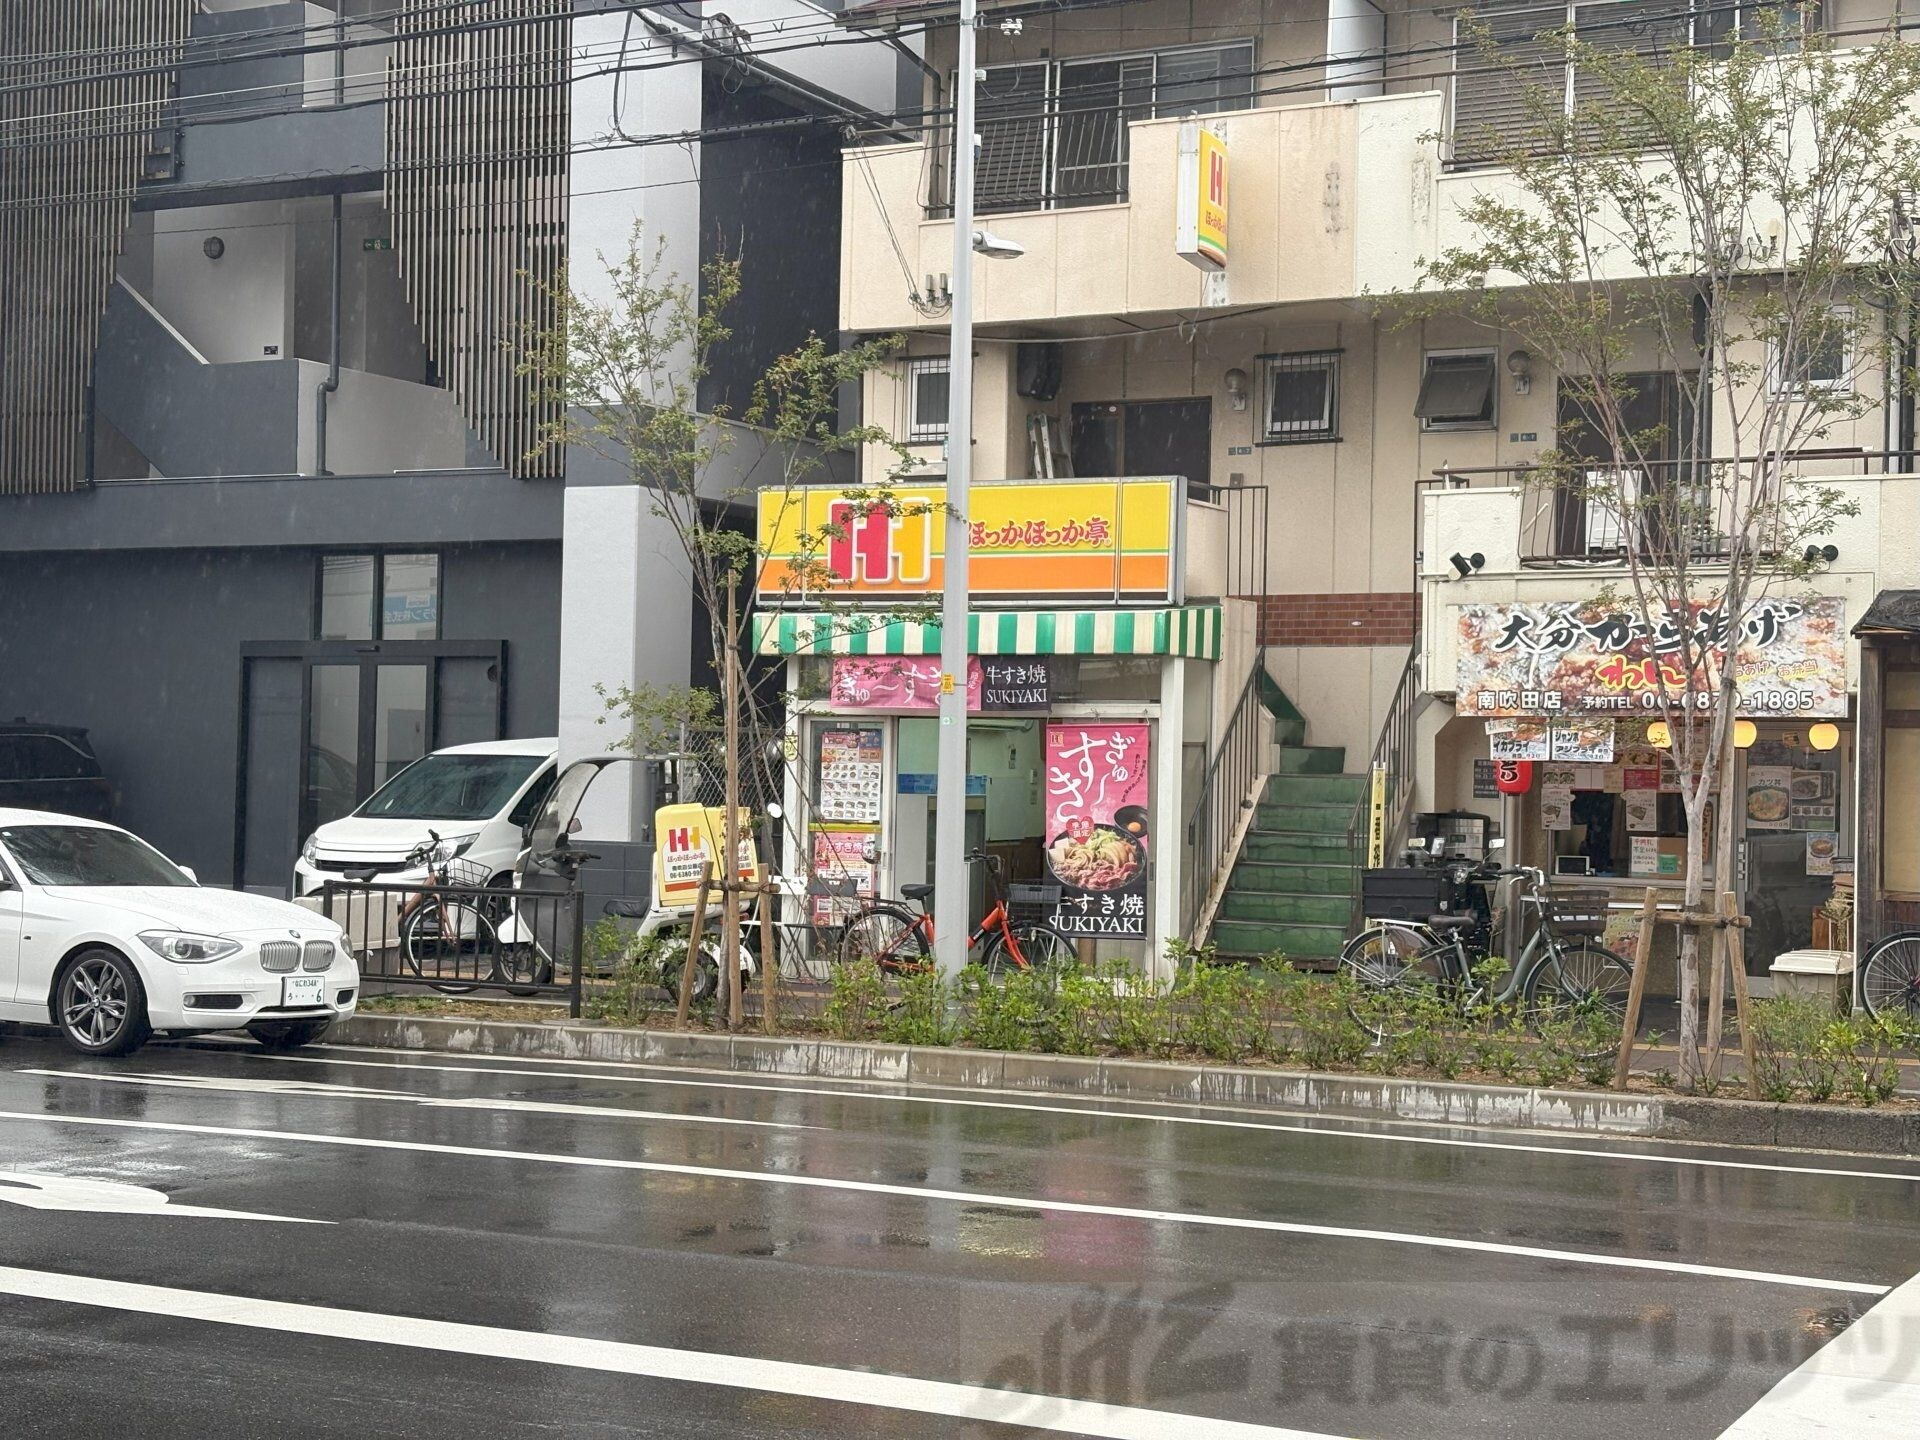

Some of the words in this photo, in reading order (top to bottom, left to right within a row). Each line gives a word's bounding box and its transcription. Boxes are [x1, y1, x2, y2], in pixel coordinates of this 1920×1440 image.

[968, 517, 1110, 547] ほっかほっか亭
[986, 665, 1046, 686] 牛すき焼
[1736, 661, 1770, 678] らあげ
[1777, 659, 1818, 677] お弁当
[986, 688, 1047, 704] SUKIYAKI
[1477, 690, 1562, 709] 南吹田店
[1582, 694, 1634, 709] 予約TEL
[1049, 915, 1144, 933] SUKIYAKI
